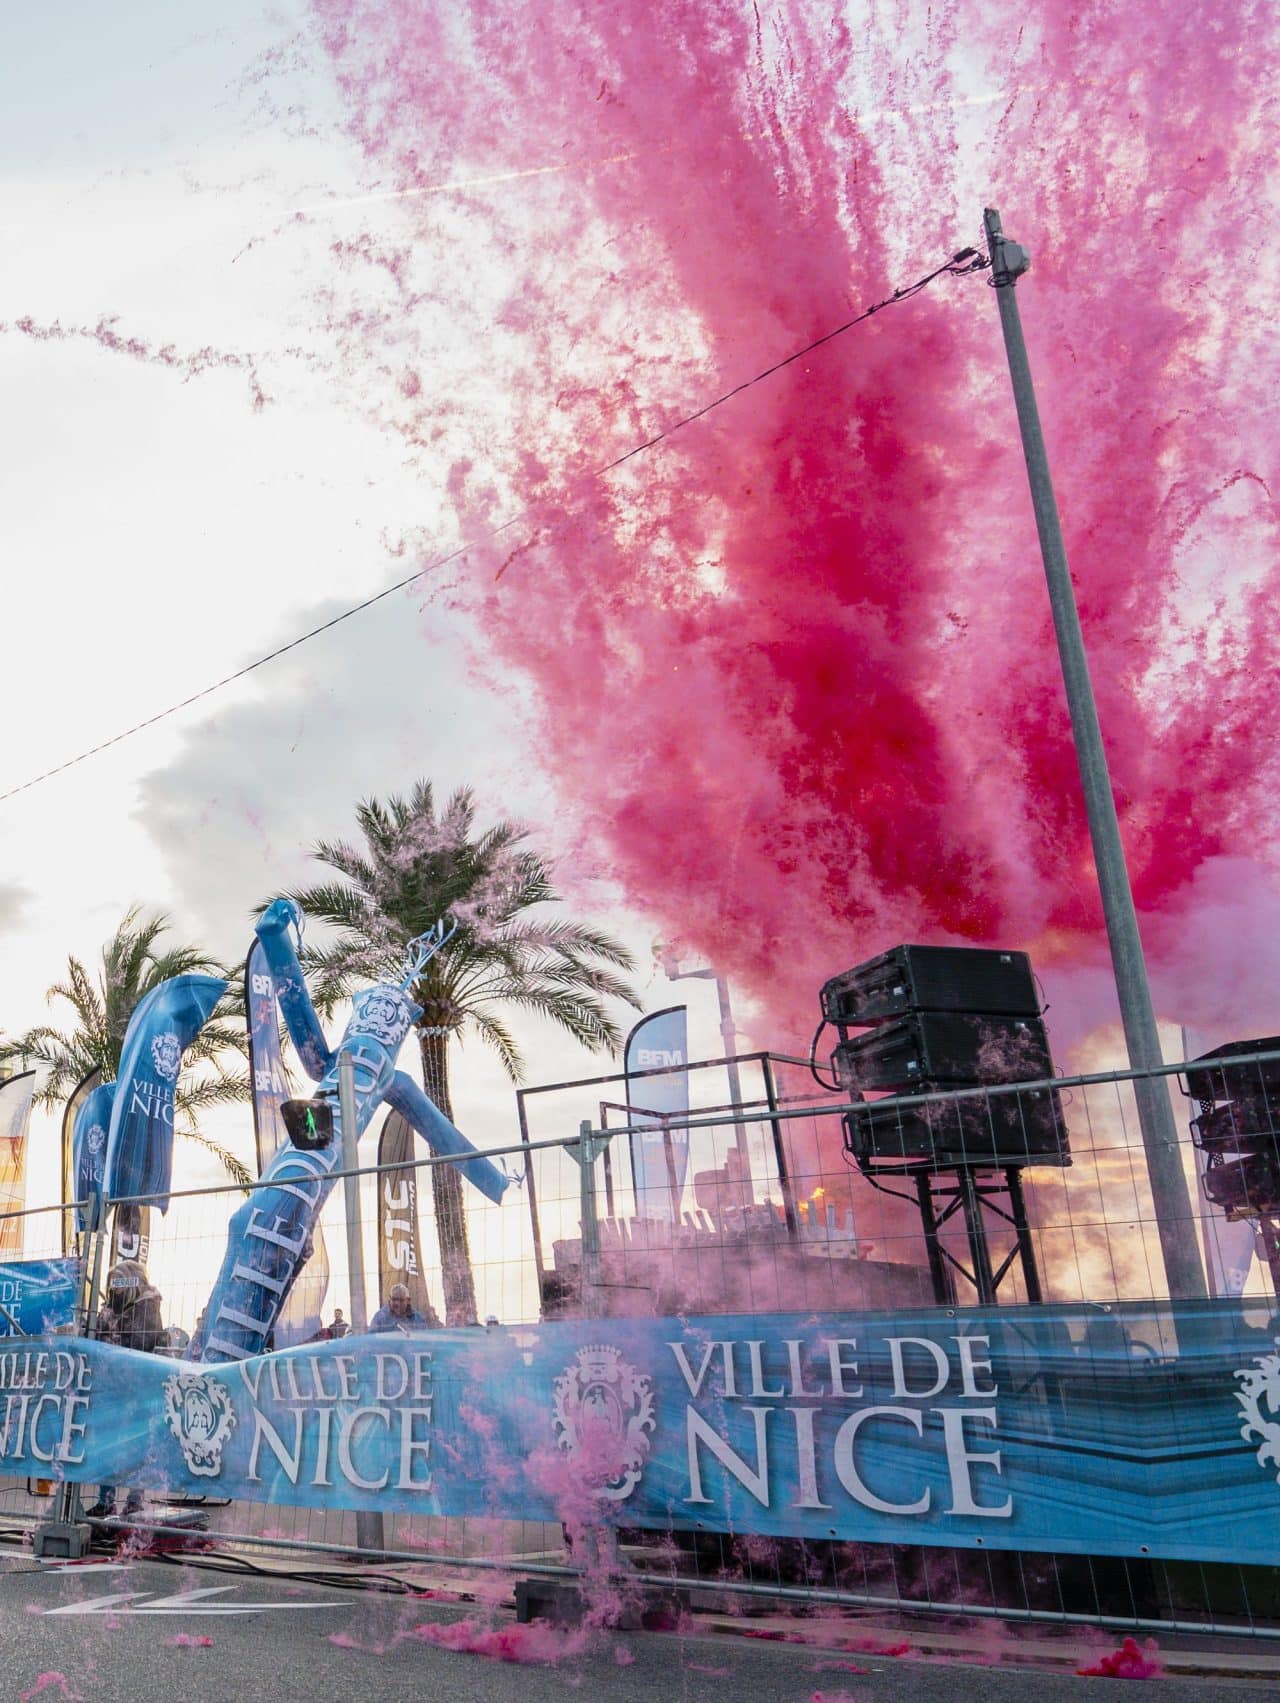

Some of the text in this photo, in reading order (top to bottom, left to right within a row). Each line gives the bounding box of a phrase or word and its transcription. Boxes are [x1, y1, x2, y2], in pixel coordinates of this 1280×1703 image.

[638, 1048, 683, 1066] BFM
[133, 1078, 170, 1102] VILLE
[384, 1177, 411, 1271] STC
[53, 1351, 93, 1391] DE
[240, 1352, 434, 1400] VILLE DE
[665, 1335, 999, 1399] VILLE DE
[245, 1405, 433, 1491] NICE
[682, 1404, 1014, 1518] NICE
